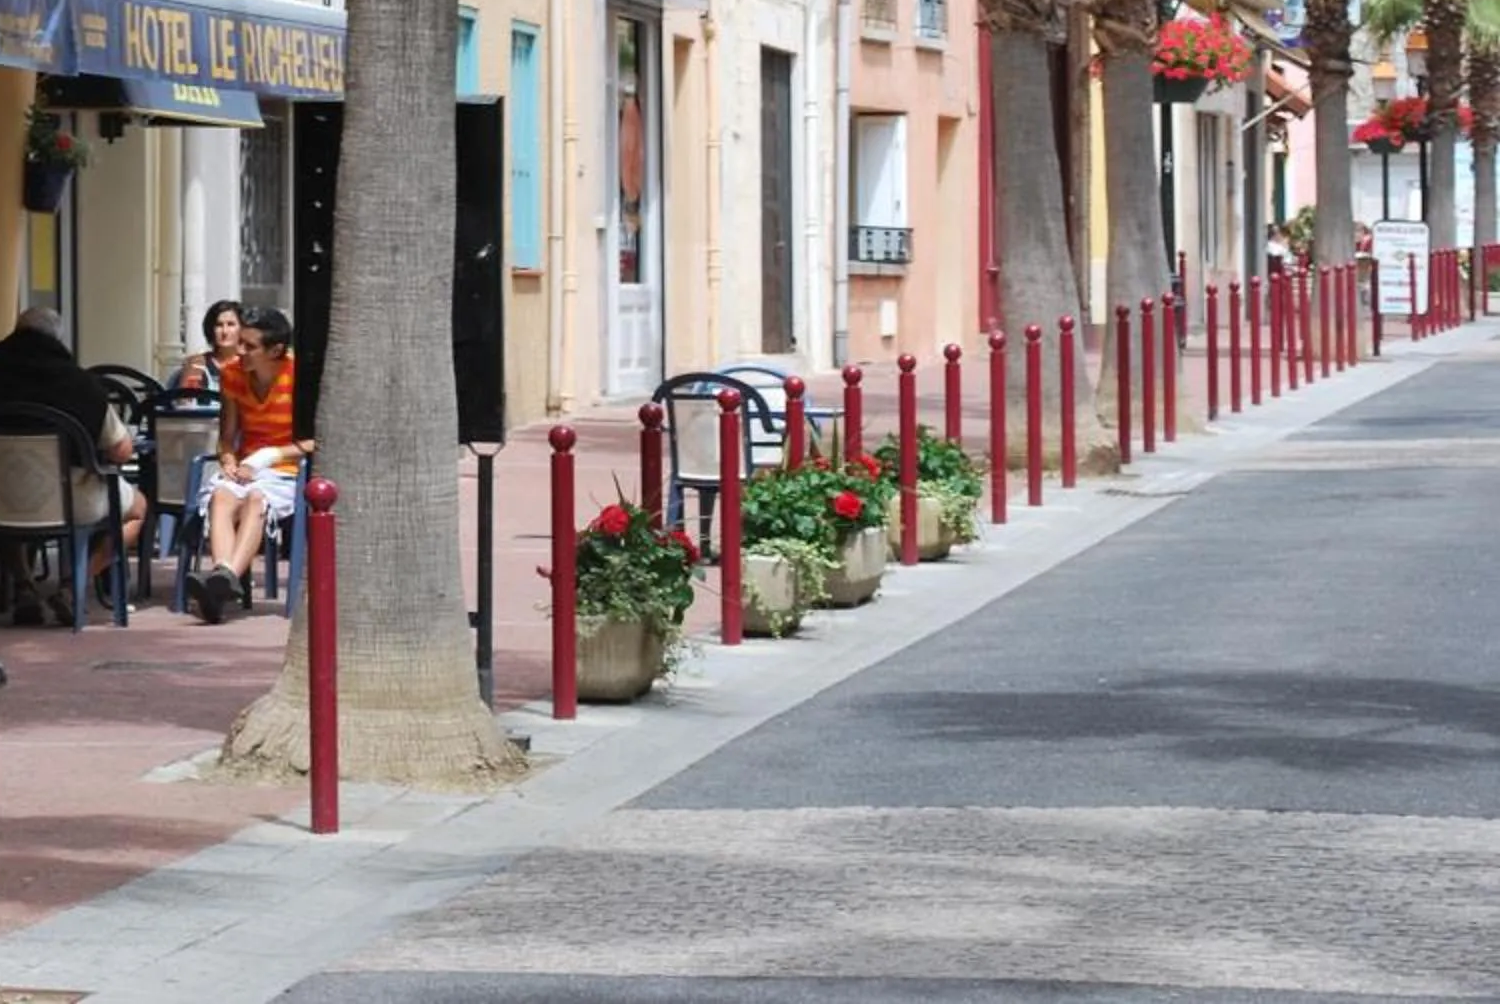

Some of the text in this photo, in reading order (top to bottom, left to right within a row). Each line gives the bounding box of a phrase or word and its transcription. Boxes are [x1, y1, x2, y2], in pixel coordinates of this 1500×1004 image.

[125, 2, 198, 75] HOTEL
[209, 16, 236, 81] LE
[241, 21, 345, 94] RICHELIEU
